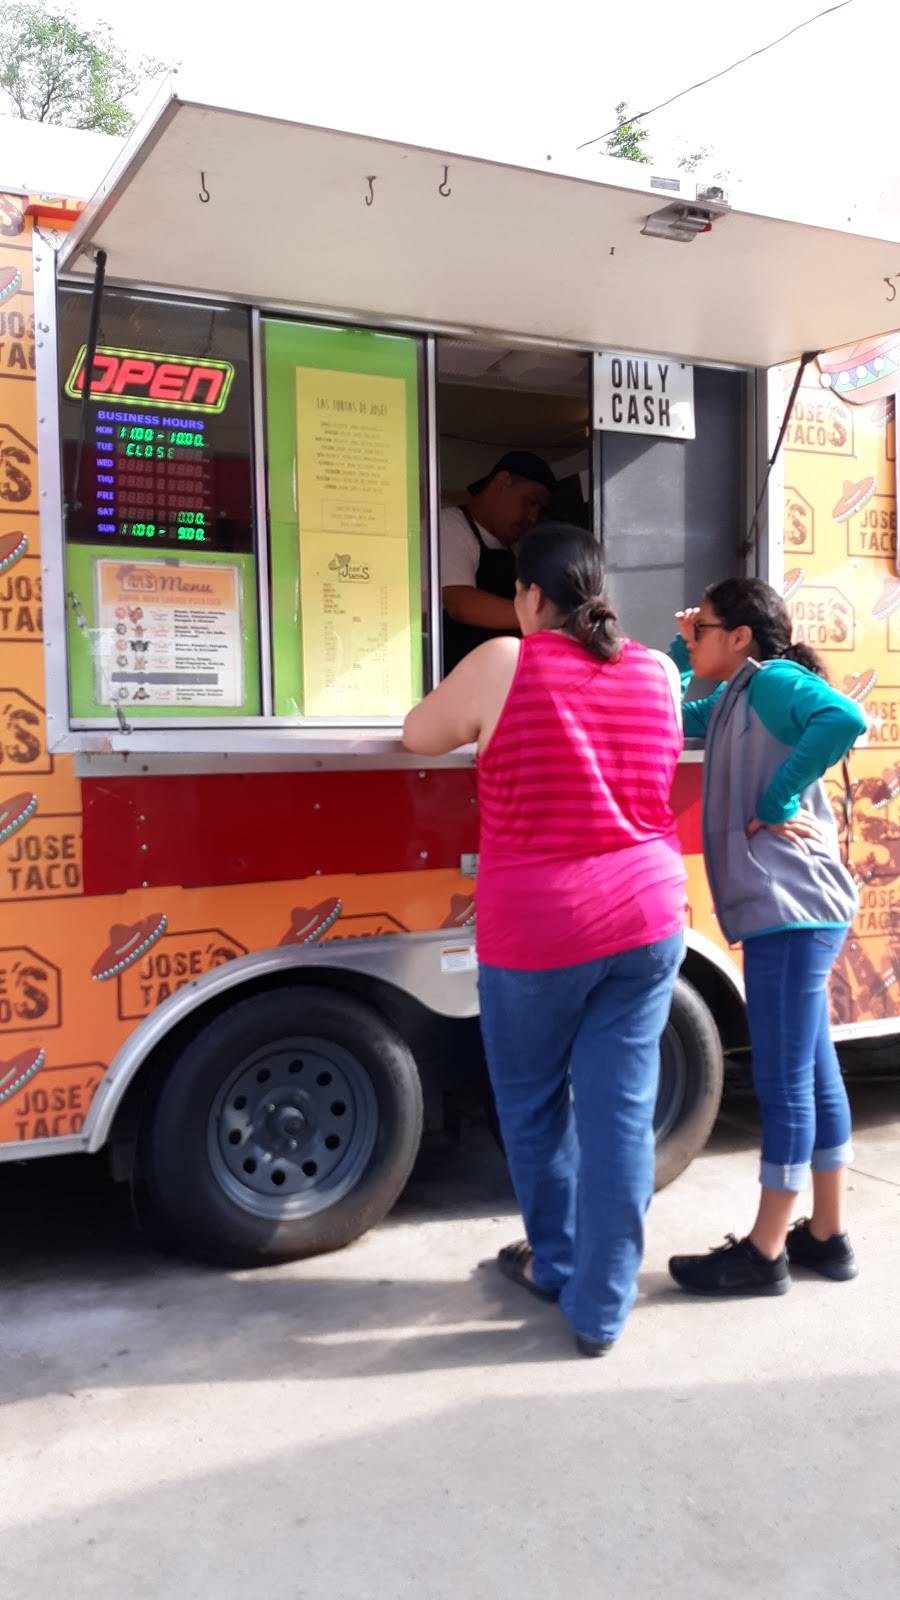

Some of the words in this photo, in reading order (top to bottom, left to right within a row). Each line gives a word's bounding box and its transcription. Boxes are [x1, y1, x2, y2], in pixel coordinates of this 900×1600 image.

[76, 354, 224, 405] OPEN
[611, 358, 669, 393] ONLY
[612, 393, 670, 427] CASH
[97, 410, 160, 425] BUSINESS
[162, 417, 205, 430] HOURS
[96, 426, 113, 434] MON
[96, 442, 113, 451] TUE
[97, 459, 113, 467] WED
[97, 475, 114, 483] THU
[97, 491, 114, 500] FRI
[97, 507, 114, 516] SAT
[97, 524, 116, 533] SUN
[160, 576, 213, 593] Menu
